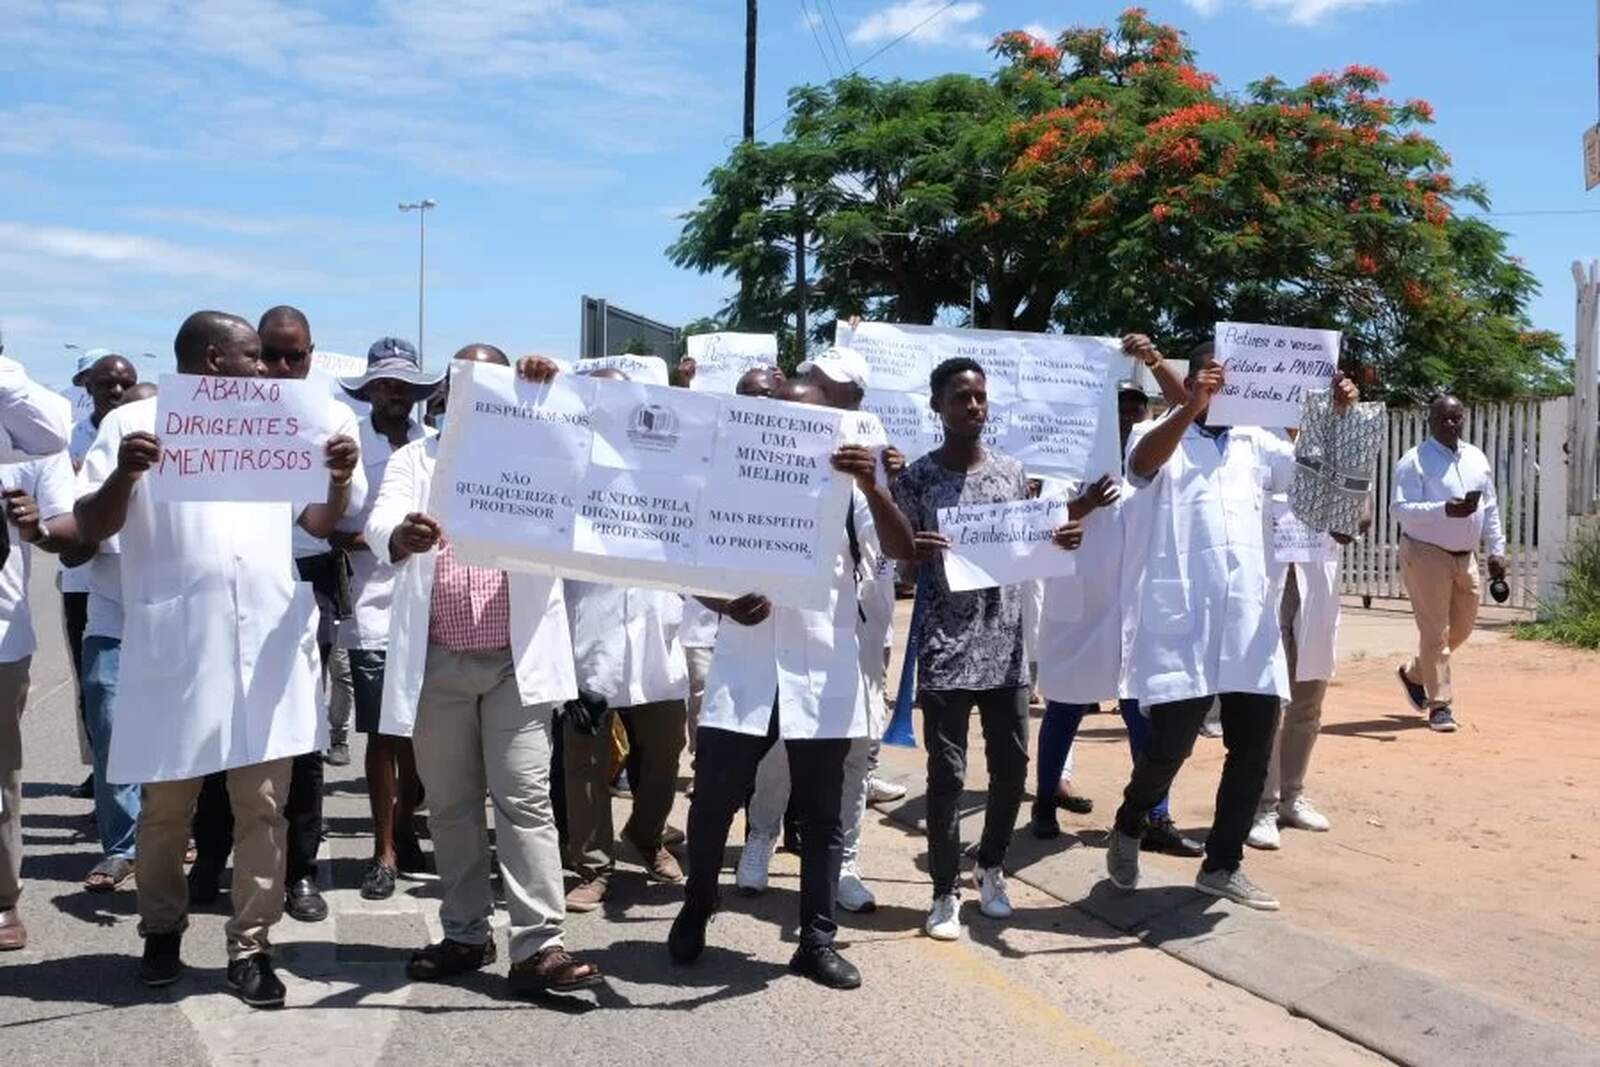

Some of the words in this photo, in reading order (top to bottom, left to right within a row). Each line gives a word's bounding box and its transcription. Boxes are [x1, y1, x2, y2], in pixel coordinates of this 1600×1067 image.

[192, 377, 280, 402] ABAIXO
[166, 412, 299, 436] DIRIGENTES
[475, 401, 590, 427] RESPEITEM-NOS
[728, 410, 834, 435] MERECEMOS
[761, 431, 797, 449] UMA
[159, 449, 312, 477] MENTIROSOS
[736, 448, 817, 469] MINISTRA
[500, 471, 531, 486] NÃO
[738, 465, 810, 486] MELHOR
[456, 481, 558, 505] QUALQUERIZE
[587, 490, 649, 508] JUNTOS
[652, 497, 690, 513] PELA
[469, 499, 554, 520] PROFESSOR
[582, 505, 668, 526] DIGNIDADE
[671, 516, 695, 529] DO
[709, 509, 744, 524] MAIS
[747, 513, 815, 530] RESPEITO
[591, 521, 681, 544] PROFESSOR
[706, 534, 726, 546] AO
